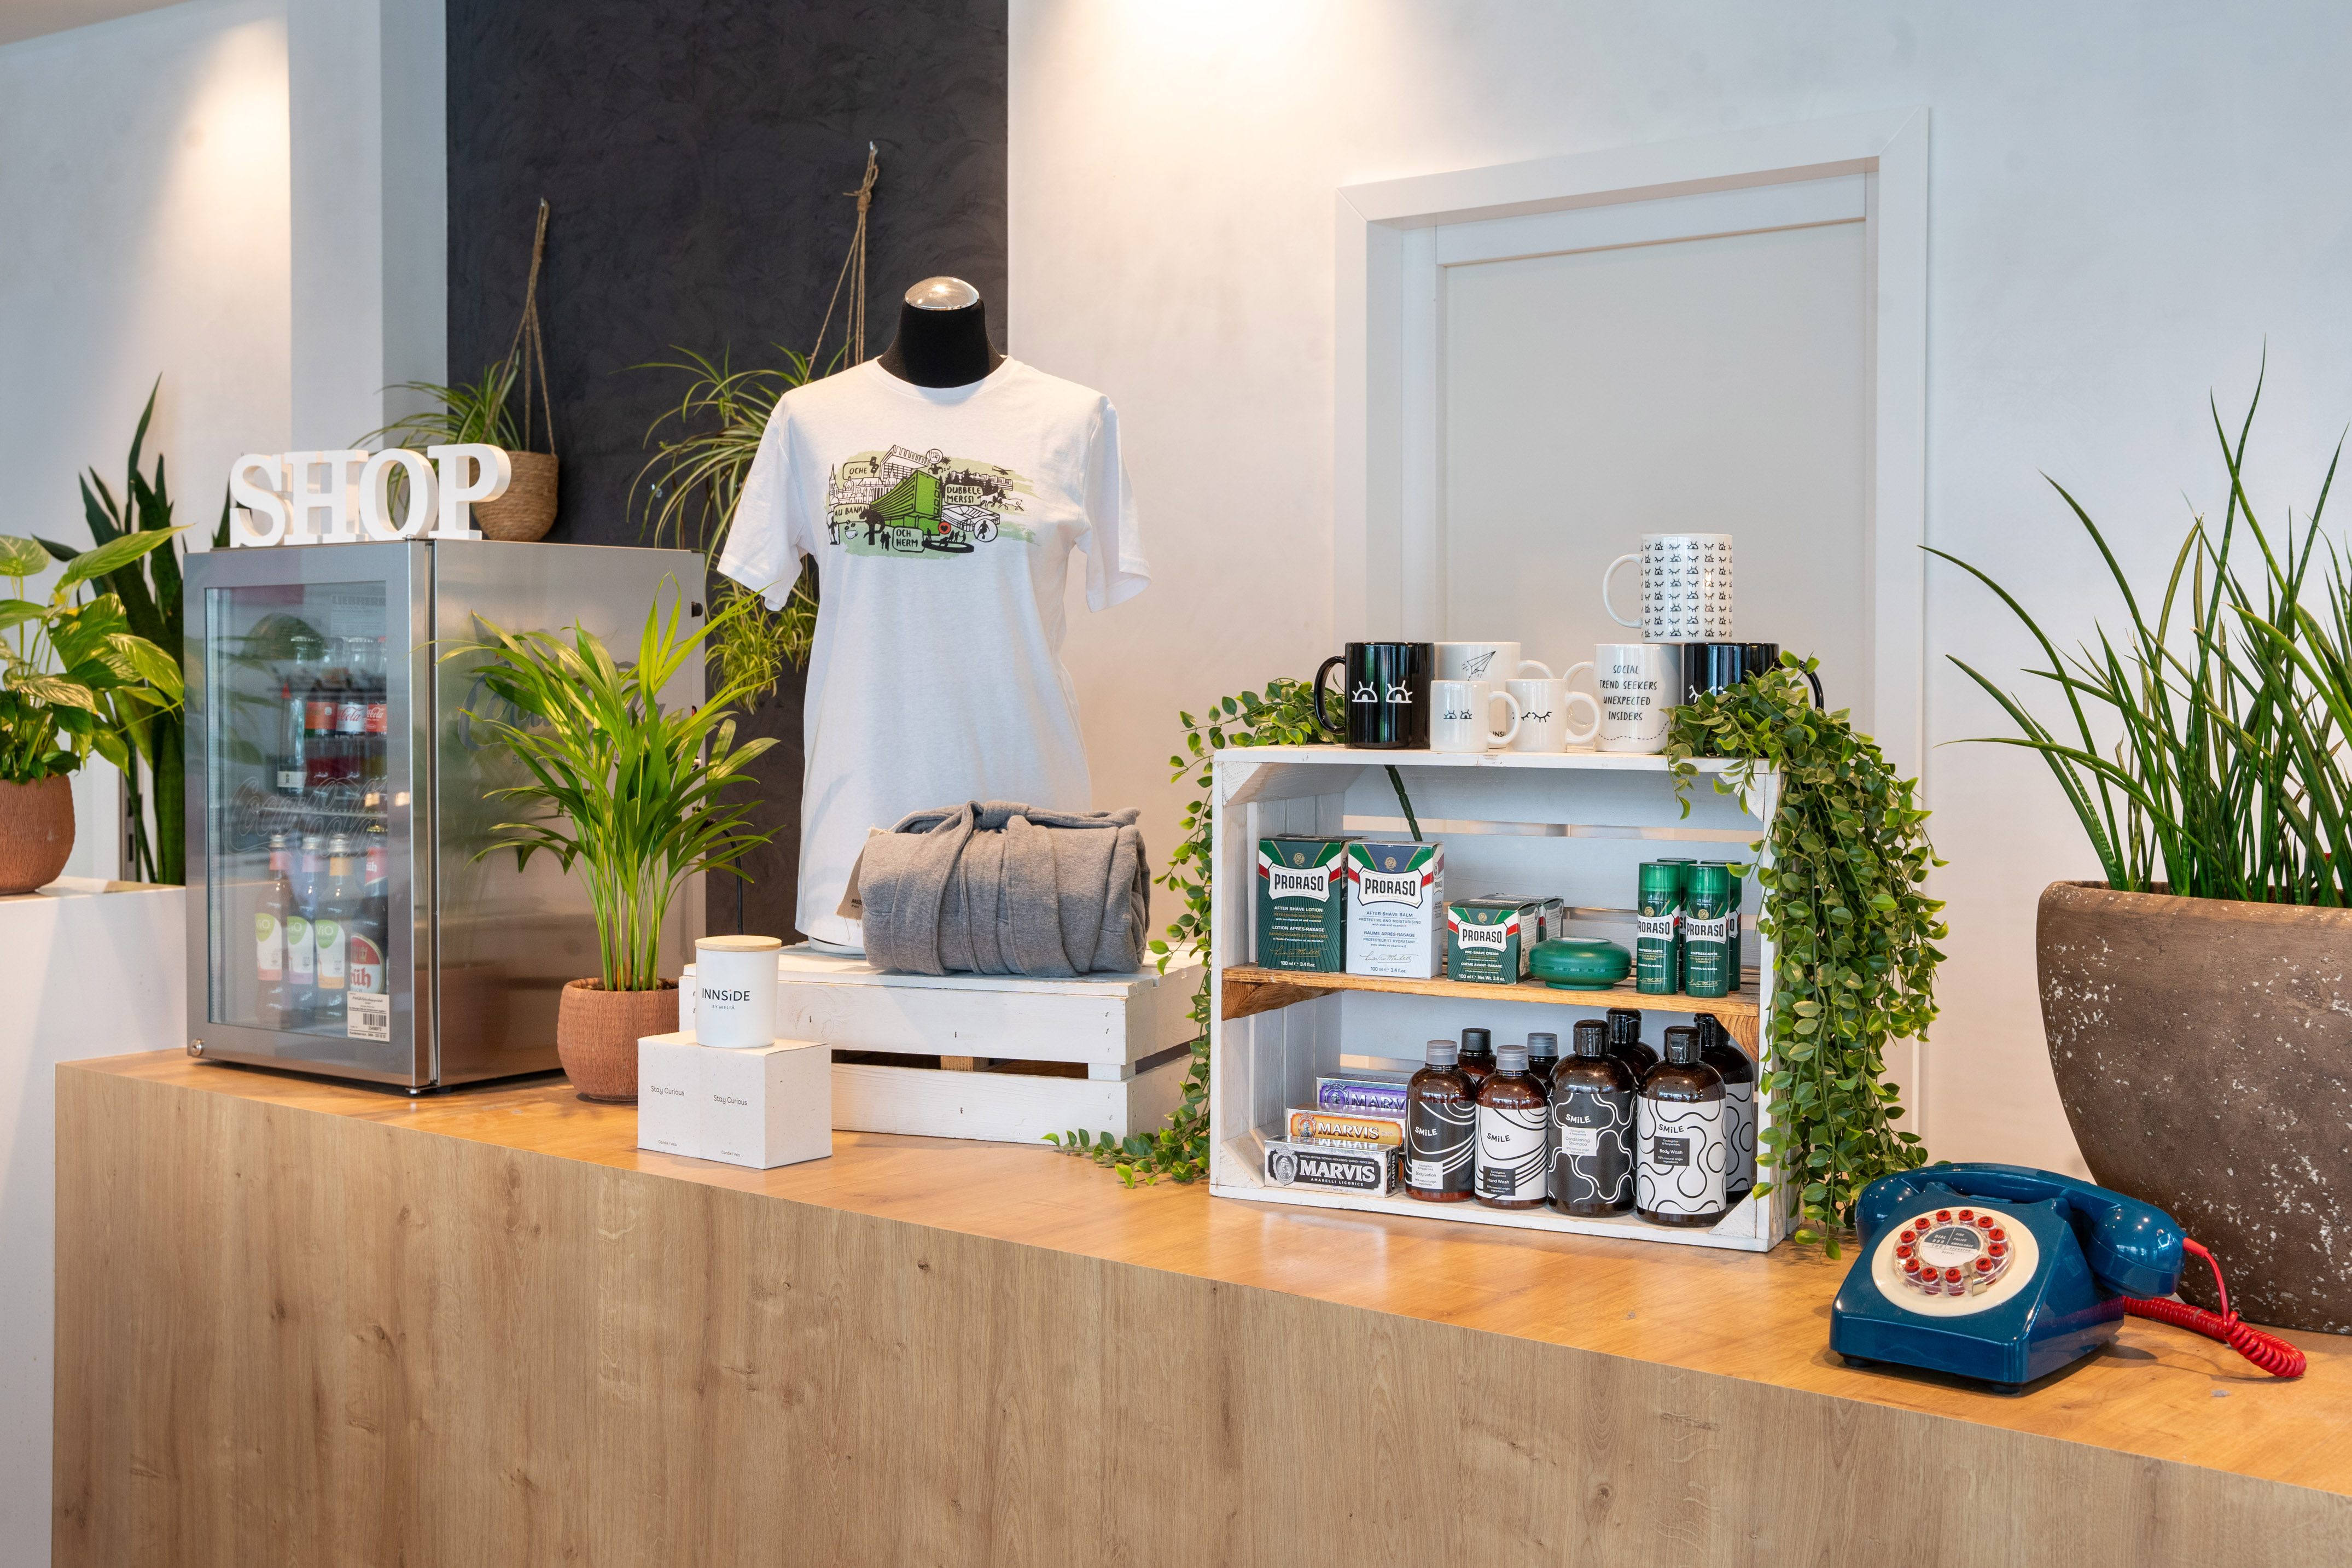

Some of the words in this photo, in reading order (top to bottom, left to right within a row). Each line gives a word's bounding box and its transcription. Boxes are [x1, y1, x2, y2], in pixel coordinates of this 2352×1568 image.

[229, 443, 511, 547] SHOP
[947, 486, 981, 494] DUBBELE
[947, 495, 974, 503] MERSSI
[834, 508, 843, 517] AU
[896, 529, 911, 538] OCH
[896, 538, 918, 547] HERM
[1613, 664, 1639, 674] SOCIAL
[1599, 680, 1619, 689] TREND
[1623, 681, 1657, 690] SEEKERS
[1603, 696, 1651, 706] UNEXPECTED
[1608, 711, 1643, 721] INSIDERS
[1274, 873, 1324, 892] PRORASO
[1365, 878, 1416, 896] PRORASO
[1687, 923, 1724, 937] PRORASO
[1463, 929, 1502, 943] PRORASO
[702, 988, 750, 1001] INNSiDE
[651, 1085, 663, 1095] Stay
[664, 1087, 685, 1096] Curious
[714, 1094, 726, 1104] Stay
[727, 1097, 748, 1106] Curious
[1352, 1093, 1406, 1110] MARV
[1318, 1122, 1380, 1140] MARVIS
[1299, 1159, 1376, 1182] MARVIS
